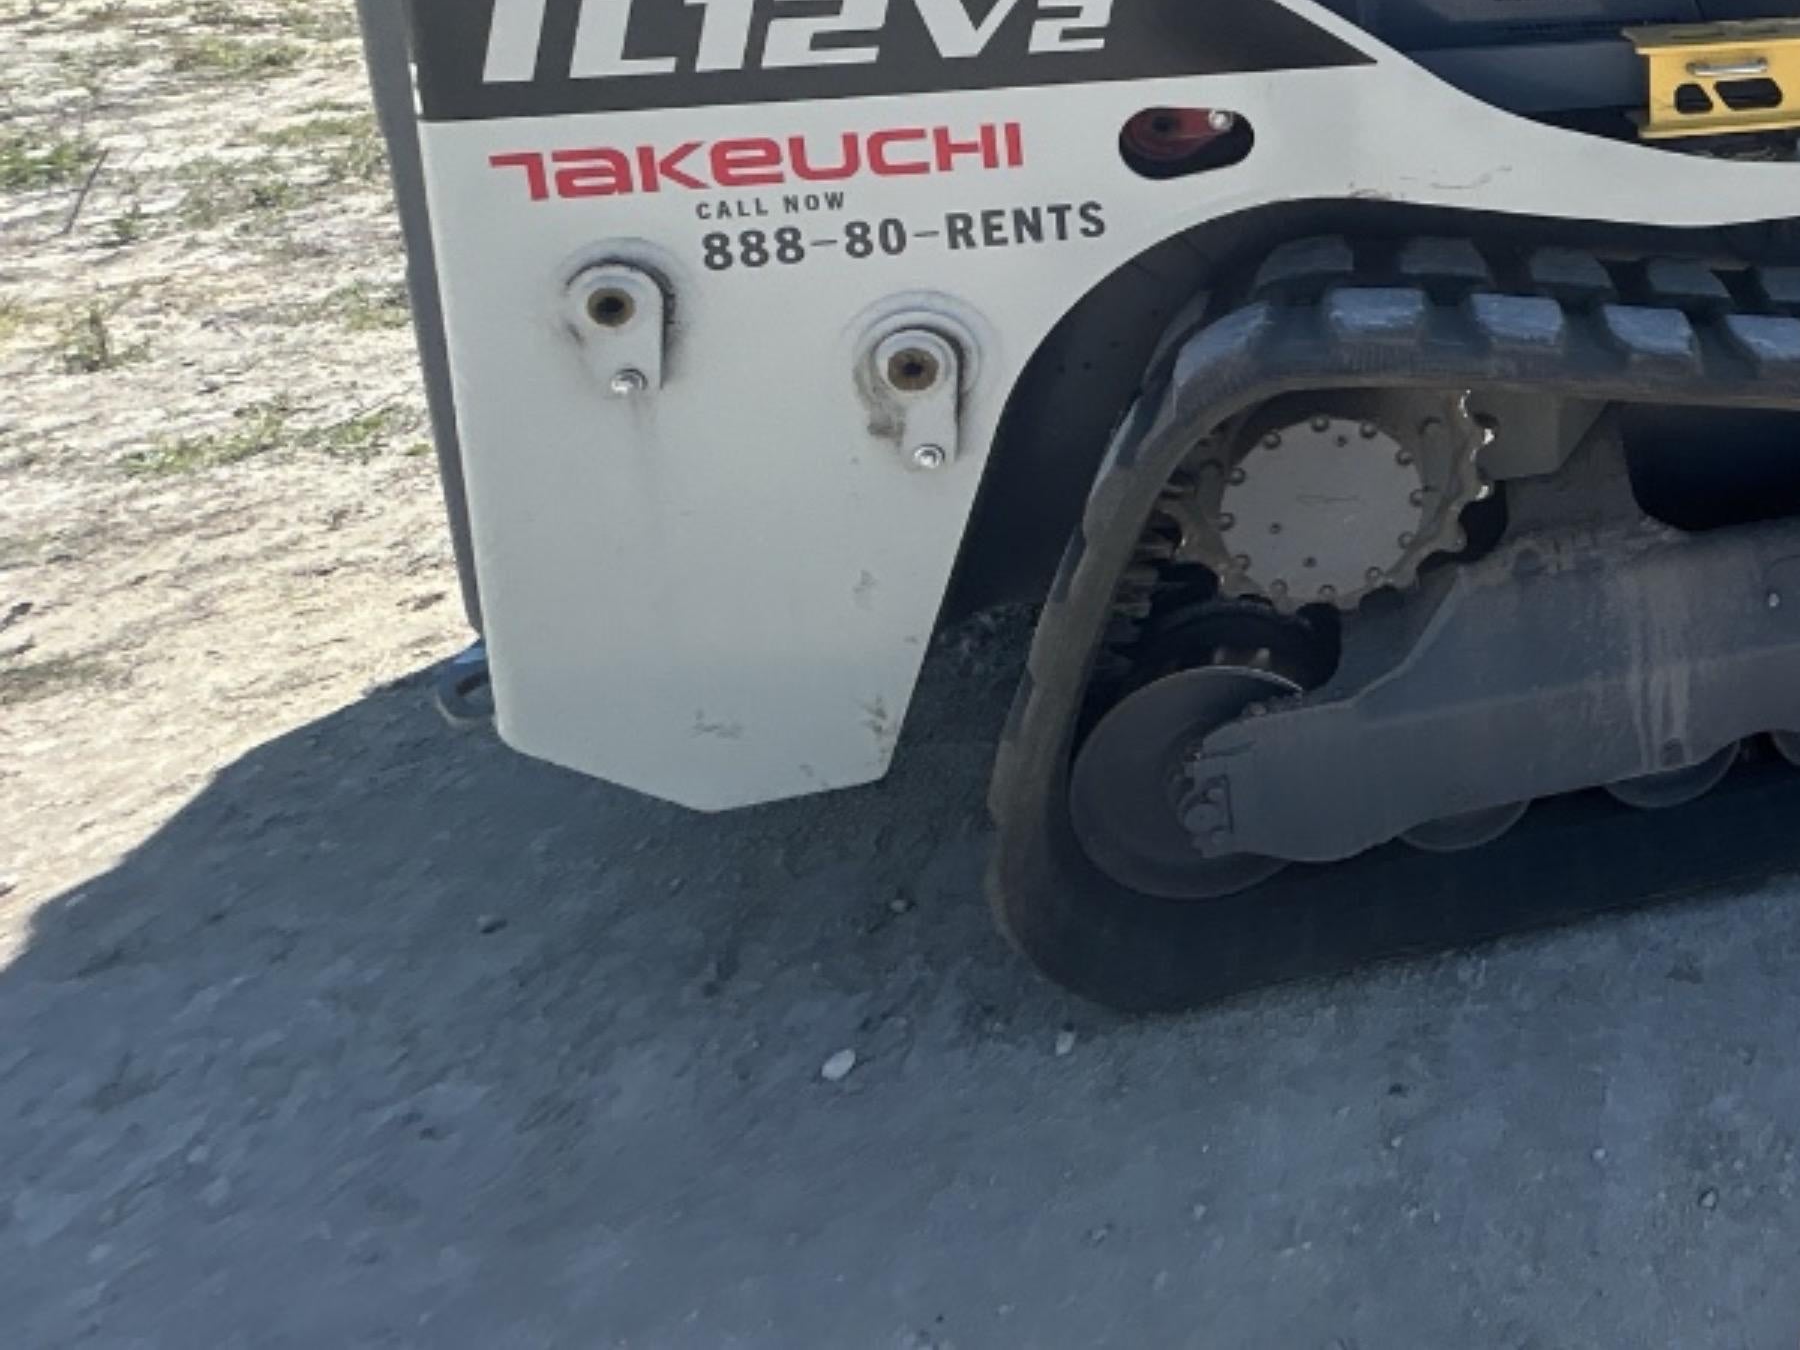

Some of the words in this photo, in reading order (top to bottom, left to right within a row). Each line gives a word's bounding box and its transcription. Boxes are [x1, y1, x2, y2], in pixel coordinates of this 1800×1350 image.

[696, 197, 769, 219] CALL
[783, 191, 845, 214] NOW
[701, 200, 1107, 271] 888-80-RENTS
